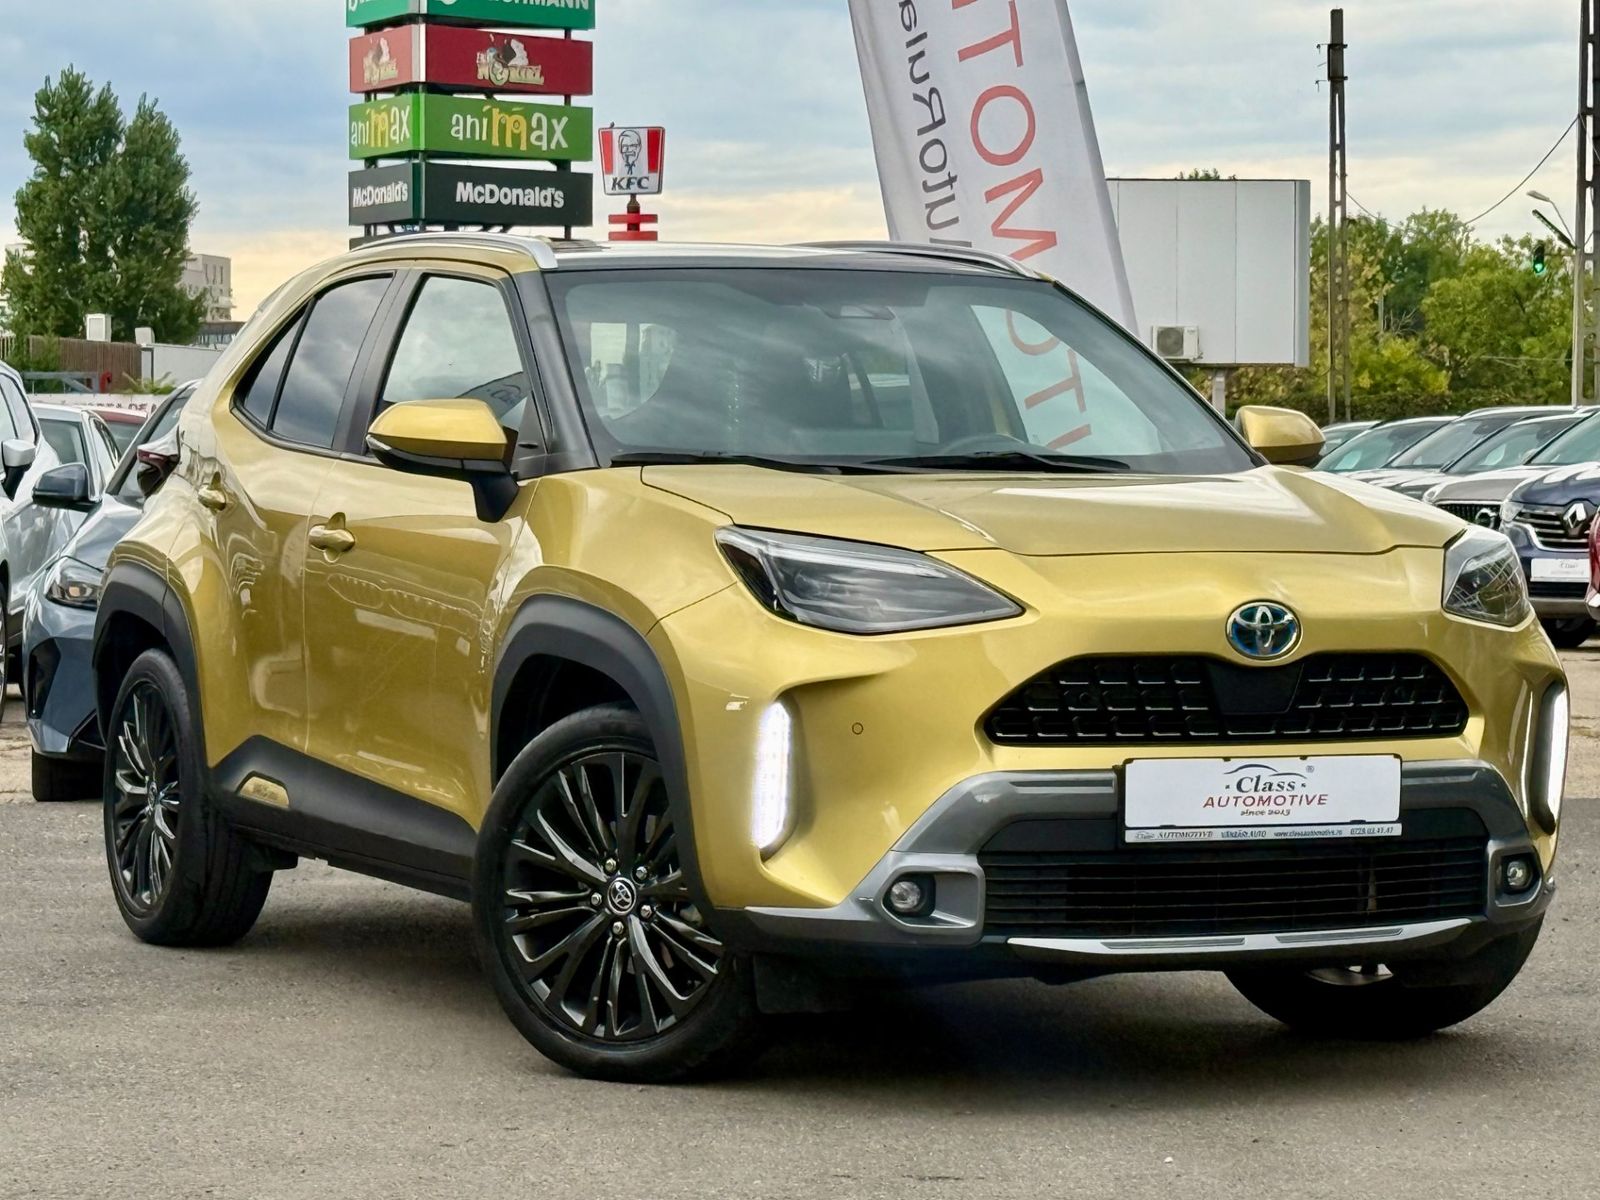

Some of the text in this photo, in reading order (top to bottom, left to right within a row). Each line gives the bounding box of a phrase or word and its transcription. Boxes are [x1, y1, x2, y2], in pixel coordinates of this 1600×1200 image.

[351, 104, 411, 148] animax
[450, 105, 569, 151] animax
[353, 180, 408, 208] McDonald's
[455, 181, 565, 209] McDonald's
[612, 177, 649, 191] KFC
[1236, 774, 1296, 793] Class
[1203, 794, 1329, 808] AUTOMOTIVE
